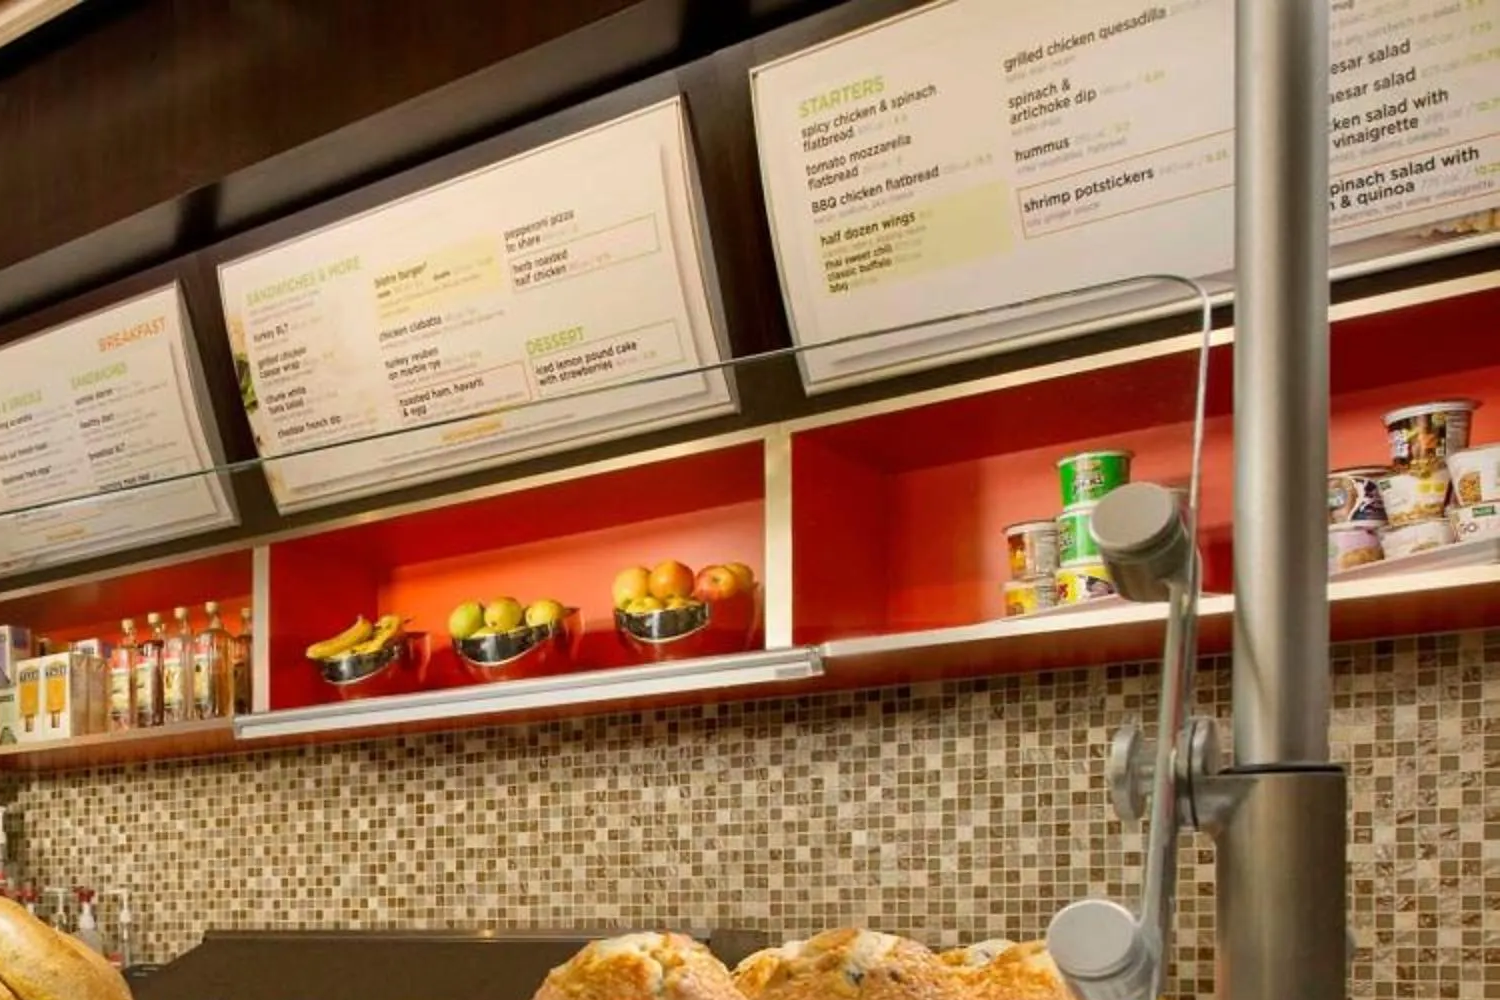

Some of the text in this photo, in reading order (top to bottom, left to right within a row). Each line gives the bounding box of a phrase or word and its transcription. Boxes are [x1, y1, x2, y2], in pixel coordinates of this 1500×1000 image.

[1002, 46, 1044, 73] grilled
[1046, 30, 1096, 56] chicken
[1099, 7, 1167, 40] quesadilla
[1368, 38, 1411, 65] salad
[1008, 77, 1071, 110] spinach &
[1373, 66, 1417, 92] salad
[800, 75, 885, 118] STARTERS
[801, 120, 830, 139] spicy
[833, 104, 876, 128] chicken
[879, 99, 888, 113] &
[891, 84, 937, 109] spinach
[1009, 96, 1071, 125] artichoke
[1075, 88, 1098, 106] dip
[1365, 100, 1408, 121] salad
[1413, 88, 1449, 110] with
[803, 126, 855, 152] flatbread
[1014, 136, 1070, 161] hummus
[1332, 117, 1419, 149] vinaigrette
[805, 154, 847, 177] tomato
[850, 134, 911, 163] mozzarella
[808, 166, 859, 191] flatbread
[1329, 170, 1385, 198] pinach
[1390, 157, 1435, 182] salad
[1441, 147, 1479, 167] with
[811, 197, 837, 214] BBQ
[839, 183, 883, 206] chicken
[886, 165, 940, 192] flatbread
[1023, 189, 1071, 213] shrimp
[1075, 167, 1154, 201] potstickers
[1340, 195, 1351, 209] &
[1357, 181, 1415, 206] quinoa
[550, 210, 575, 226] pizza
[820, 231, 842, 248] half
[844, 221, 879, 241] dozen
[881, 211, 916, 231] wings
[518, 235, 541, 249] share
[533, 264, 567, 282] chicken
[98, 316, 166, 352] BREAKFAST
[526, 326, 585, 355] DESSERT
[556, 355, 583, 370] lemon
[585, 346, 614, 363] pound
[615, 341, 637, 355] cake
